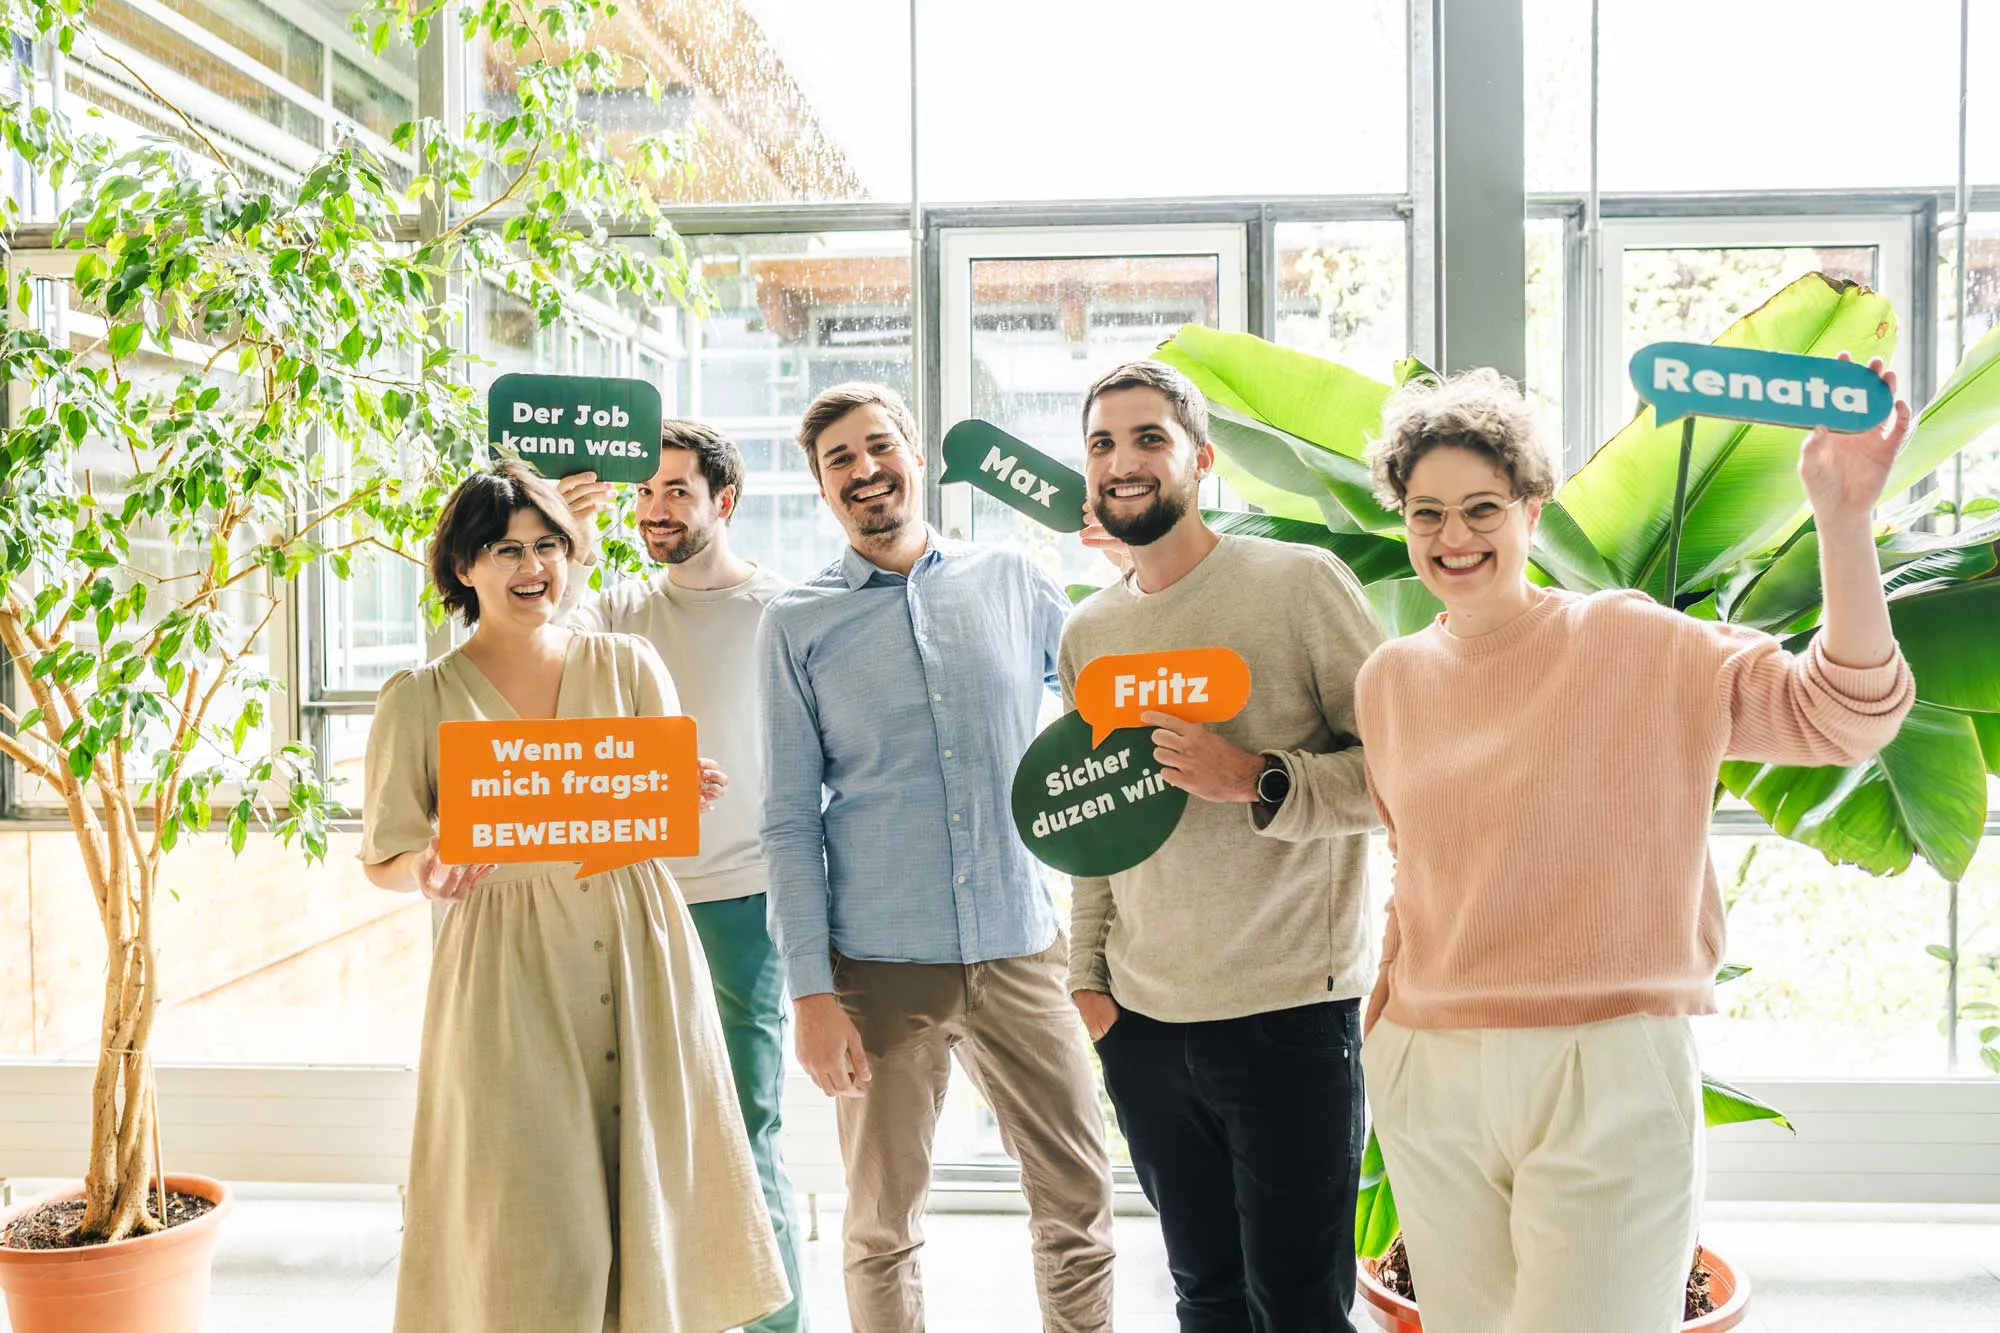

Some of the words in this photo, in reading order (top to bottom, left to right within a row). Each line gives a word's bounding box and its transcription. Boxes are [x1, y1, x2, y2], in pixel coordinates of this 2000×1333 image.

[1653, 357, 1869, 414] Renata
[512, 402, 564, 424] Der
[574, 404, 630, 428] Job
[501, 430, 575, 455] kann
[585, 439, 649, 458] was.
[979, 445, 1060, 508] Max
[1114, 667, 1209, 708] Fritz
[491, 738, 583, 762] Wenn
[594, 736, 635, 759] du
[471, 769, 551, 797] mich
[561, 770, 669, 799] fragst:
[1045, 747, 1131, 797] Sicher
[1032, 792, 1116, 839] duzen
[1120, 768, 1174, 803] wir
[472, 817, 669, 848] BEWERBEN!
